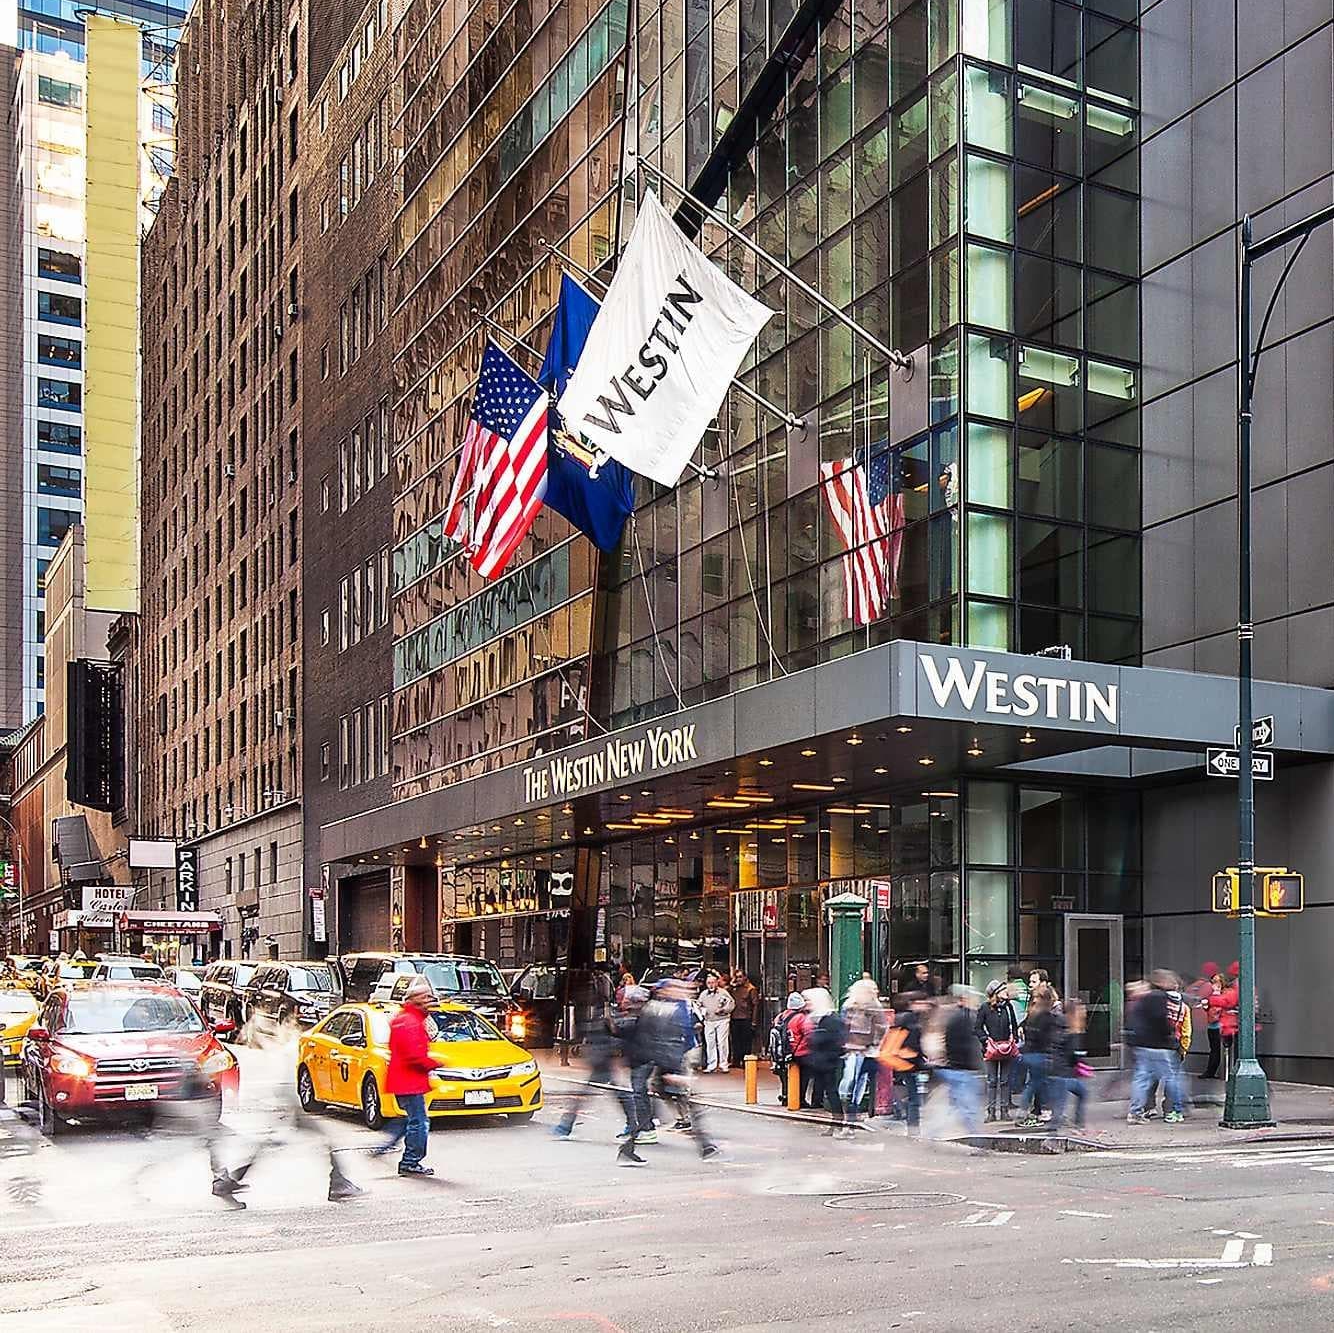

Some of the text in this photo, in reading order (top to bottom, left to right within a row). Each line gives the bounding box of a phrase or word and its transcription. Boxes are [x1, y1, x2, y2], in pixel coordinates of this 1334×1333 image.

[583, 268, 704, 435] WESTIN
[918, 654, 1119, 725] WESTIN
[523, 724, 698, 803] THE WESTIN NEW YORK
[1217, 757, 1237, 769] ONE
[95, 888, 127, 899] HOTEL
[179, 851, 195, 912] PARKIN
